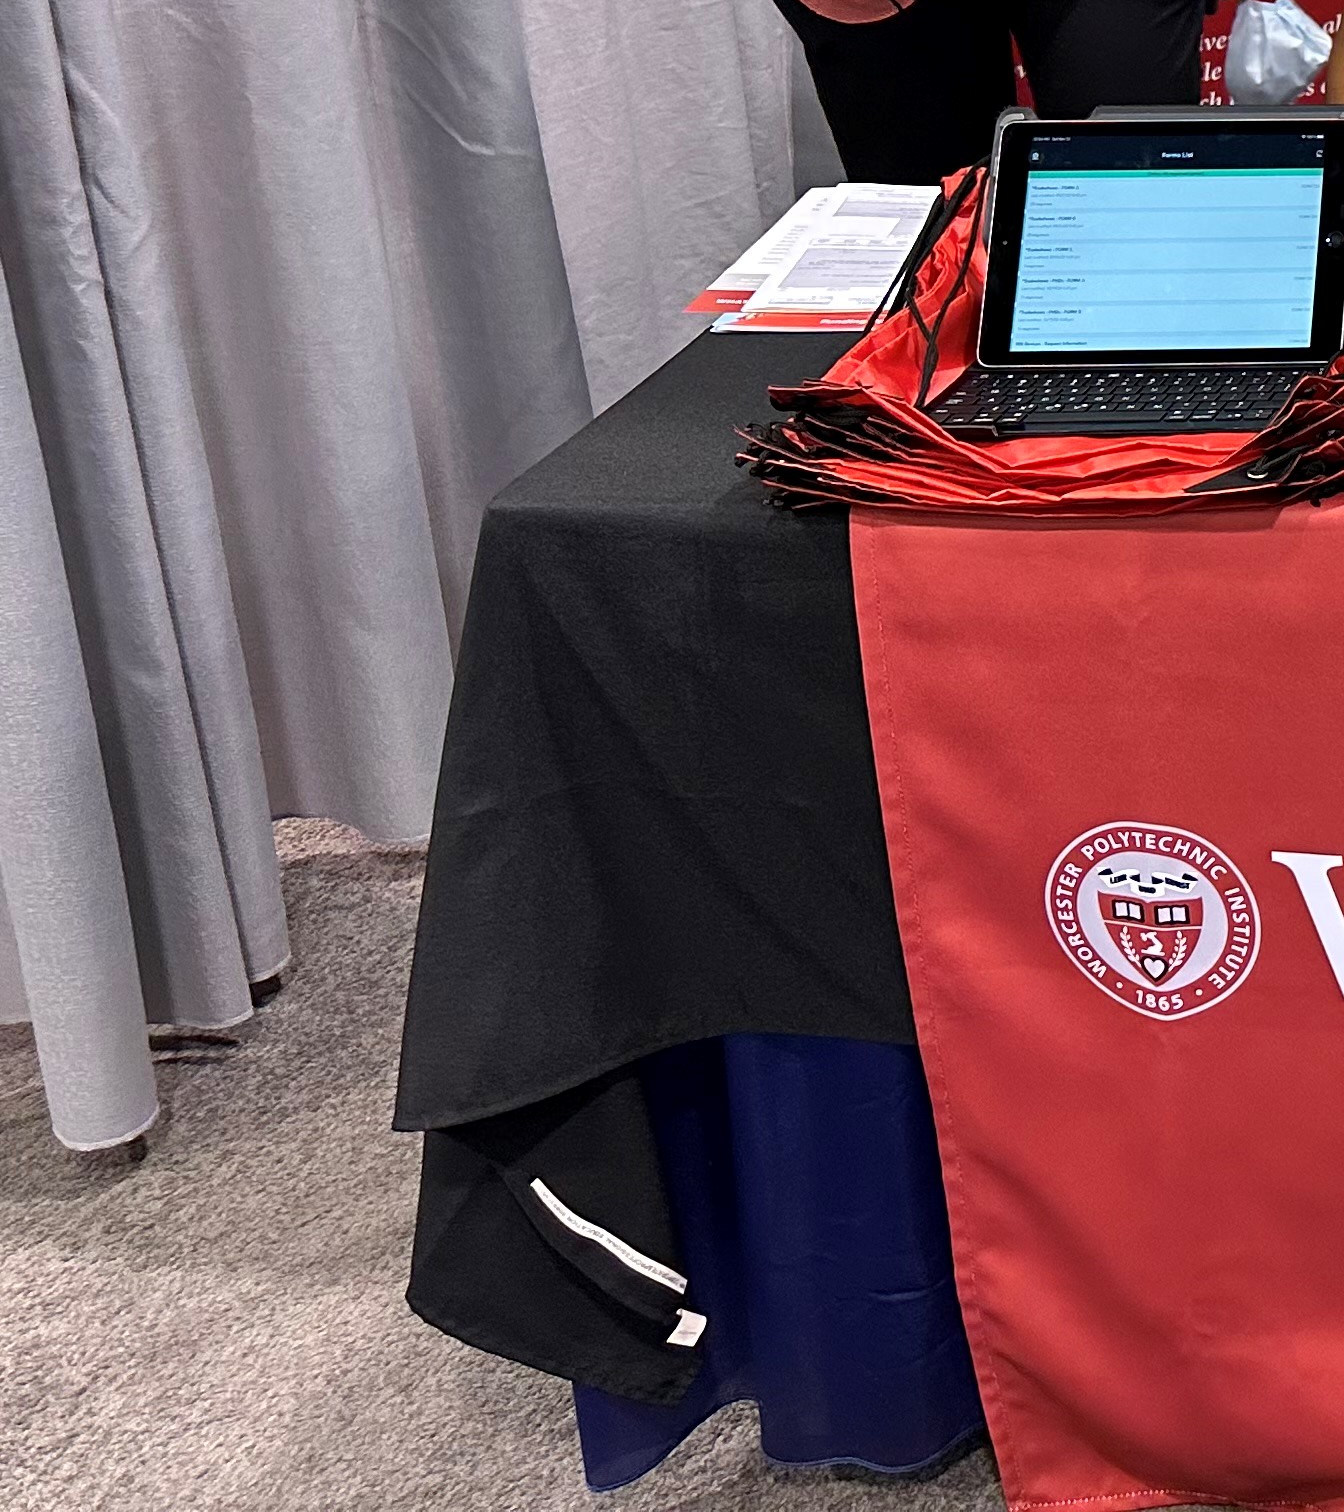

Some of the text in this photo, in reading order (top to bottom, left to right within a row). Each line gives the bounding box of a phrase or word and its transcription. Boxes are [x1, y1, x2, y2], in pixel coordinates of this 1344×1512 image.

[1055, 831, 1251, 990] WORCESTER POLYTECHNIC INSTITUTE
[1135, 989, 1184, 1011] 1865
